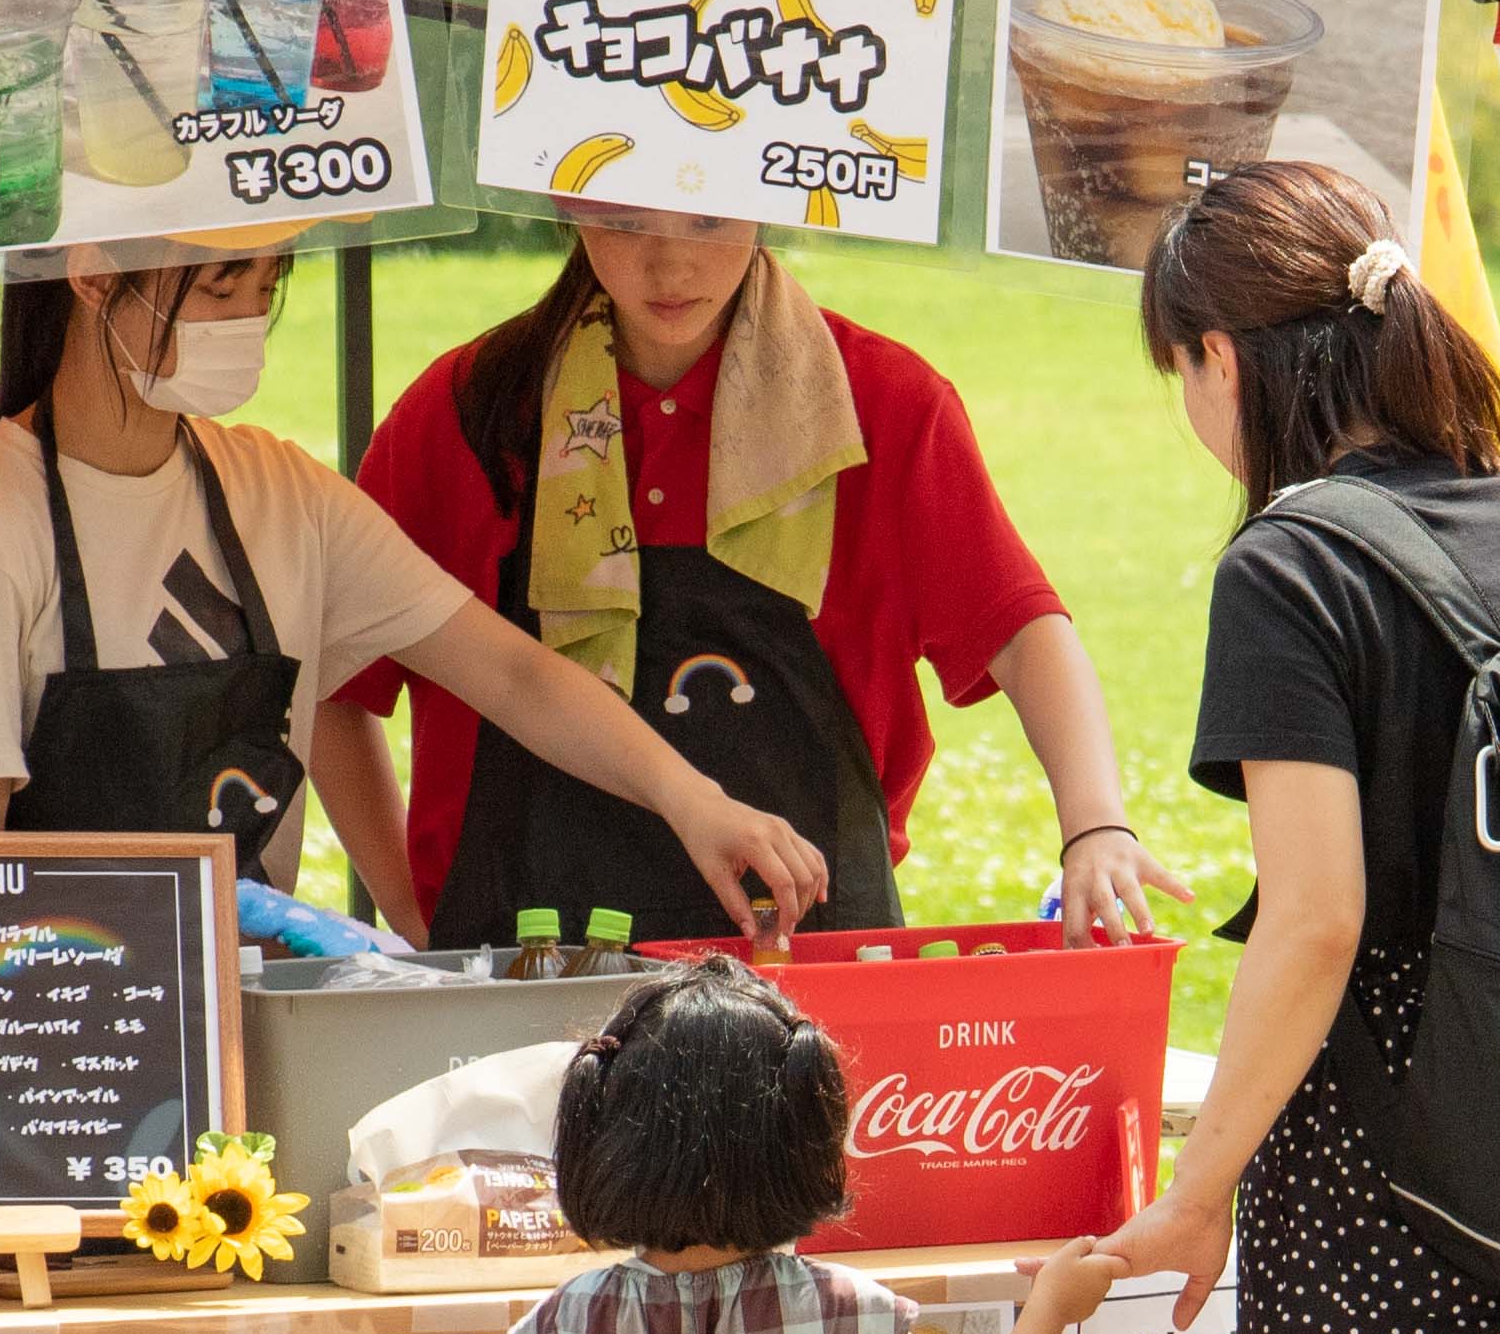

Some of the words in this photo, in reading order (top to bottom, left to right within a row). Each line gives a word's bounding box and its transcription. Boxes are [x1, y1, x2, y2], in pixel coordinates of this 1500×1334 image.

[173, 109, 266, 143] カラフル
[274, 98, 343, 131] ソーダ
[764, 147, 896, 199] 250円
[3, 945, 124, 967] クリームソーダ
[46, 985, 90, 1004] イチゴ
[122, 985, 164, 1003] コーラ
[114, 1019, 146, 1035] モモ
[939, 1020, 1016, 1049] DRINK
[71, 1055, 140, 1072] マスカット
[18, 1088, 120, 1105] パインアップル
[844, 1064, 1105, 1159] Coca-Cola
[20, 1118, 123, 1136] バタフライピー
[920, 1161, 960, 1170] TRADE
[963, 1159, 999, 1168] MARK
[486, 1209, 551, 1230] PAPER
